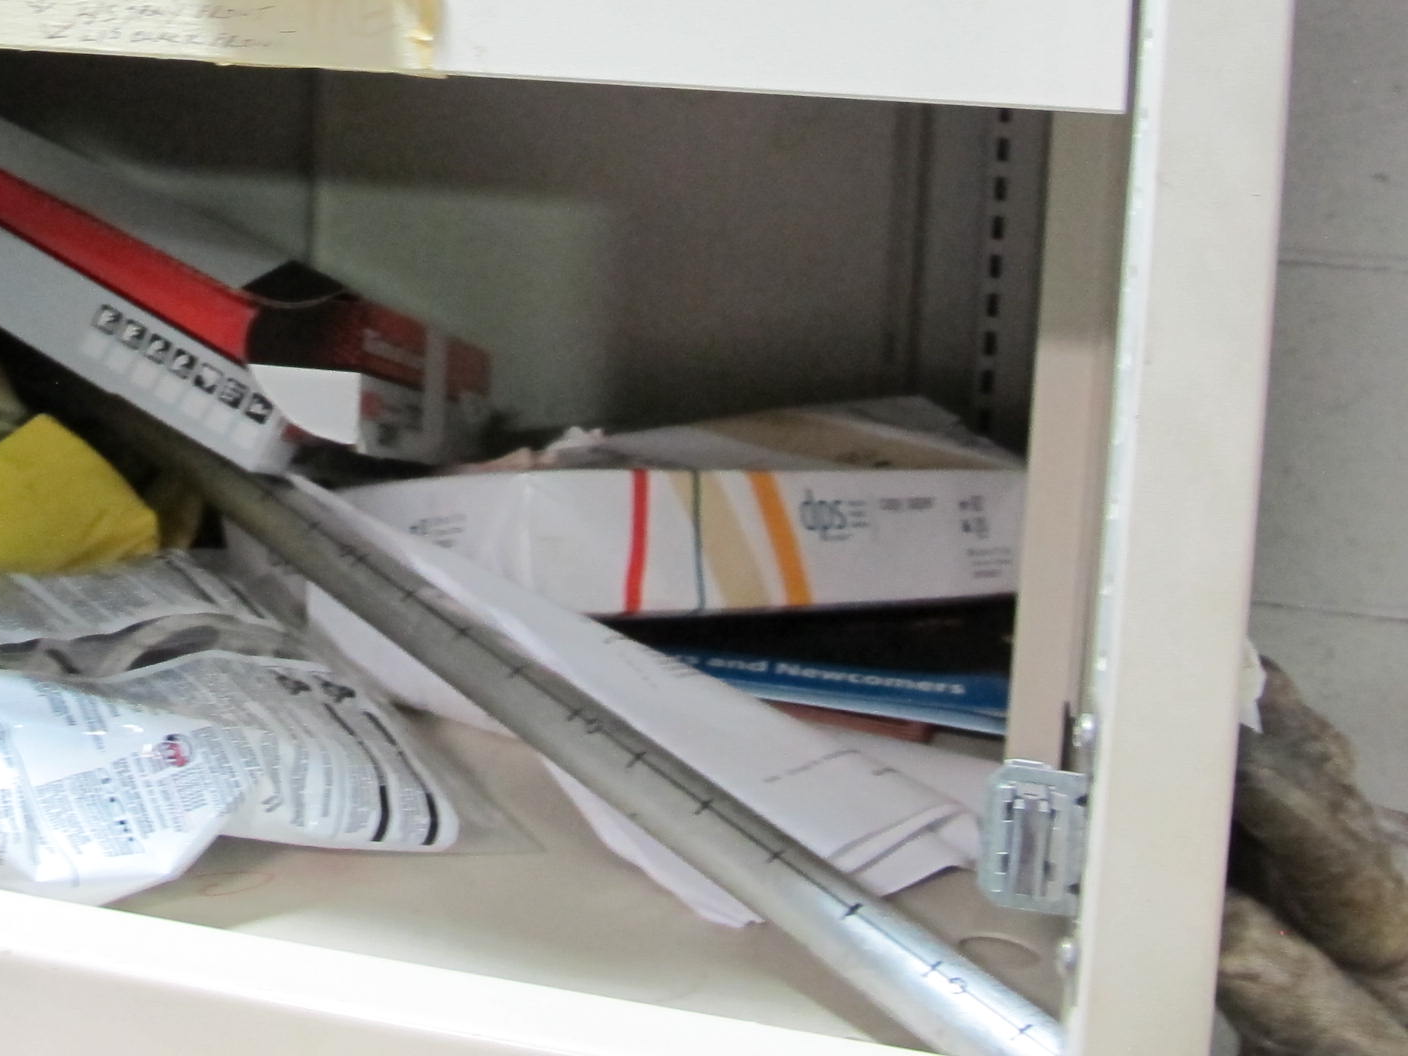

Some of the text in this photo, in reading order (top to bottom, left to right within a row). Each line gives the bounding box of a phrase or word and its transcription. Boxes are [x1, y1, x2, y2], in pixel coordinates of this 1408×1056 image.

[799, 488, 847, 536] dps
[705, 656, 768, 673] and
[773, 661, 967, 696] Newcomers
